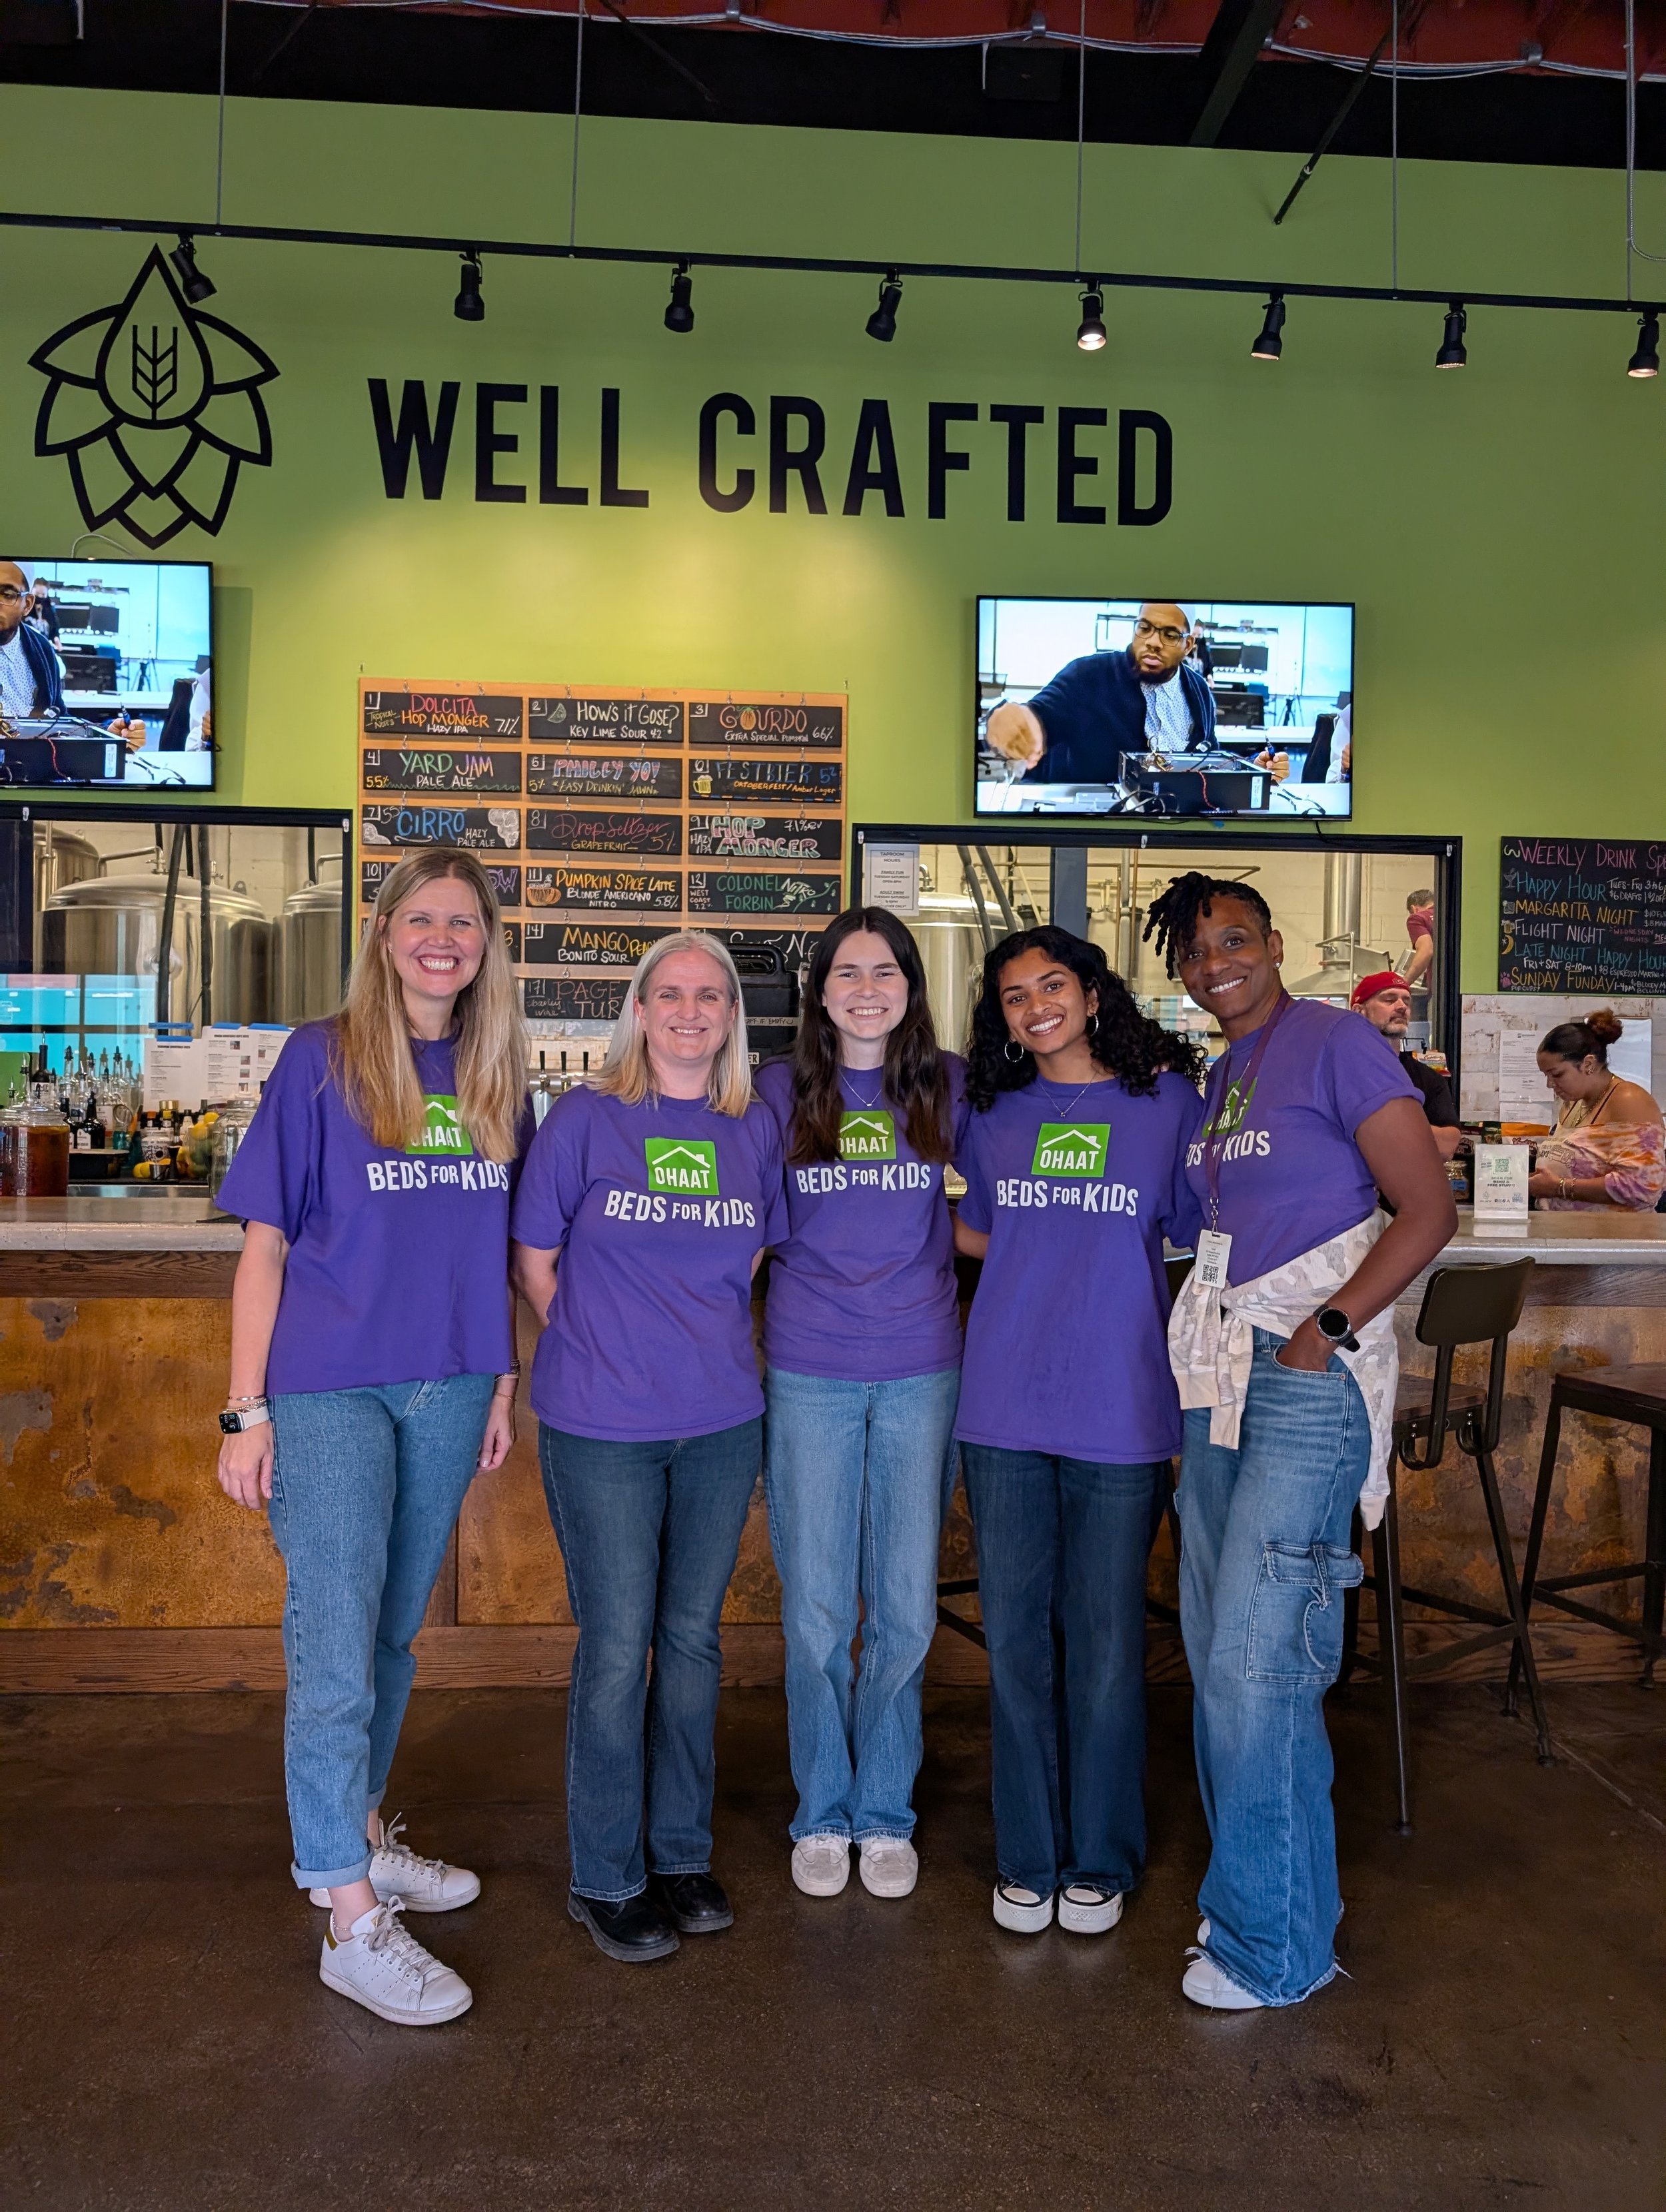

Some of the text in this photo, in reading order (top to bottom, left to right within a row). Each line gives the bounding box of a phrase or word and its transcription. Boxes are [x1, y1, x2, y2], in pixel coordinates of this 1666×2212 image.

[367, 378, 1173, 526] WELL CRAFTED
[411, 694, 477, 716] DOLCITA
[532, 701, 541, 711] 2
[695, 704, 704, 714] 3
[367, 710, 397, 722] TROPICAL
[402, 710, 489, 728] HOP MONGER
[577, 701, 619, 722] HOW'S
[638, 704, 680, 734] GOSE?
[427, 724, 468, 734] HAZY IPA
[570, 725, 588, 738] KEY
[592, 726, 616, 738] LIME
[620, 726, 647, 740] SOUR
[724, 731, 749, 741] EXTRA
[750, 732, 780, 742] SPECIAL
[367, 751, 376, 764] 4
[399, 751, 493, 778] YARD JAM
[552, 758, 660, 784] PHILLY YO!
[715, 762, 813, 784] FESTBIER
[416, 775, 474, 788] PALE ALE
[528, 778, 545, 792] 5%
[558, 780, 584, 793] EASY
[626, 785, 654, 795] JAWN
[367, 808, 375, 818] 7
[530, 810, 540, 827] 8
[690, 816, 700, 828] 9
[466, 828, 488, 839] HAZY
[551, 814, 671, 843] Drop Seltzer
[711, 816, 766, 838] HOP
[457, 837, 496, 847] PALE ALE
[690, 833, 712, 846] HAZY
[696, 844, 712, 853] IPA
[716, 837, 821, 858] MONGER
[1518, 839, 1587, 875] WEEKLY
[1597, 843, 1637, 869] DRINK
[367, 863, 379, 877] 10
[691, 873, 702, 885] 12
[556, 869, 676, 892] PUMPKIN SPICE LATTE
[716, 874, 783, 892] COLONEL
[1517, 870, 1607, 902] HAPPY HOUR
[566, 887, 651, 901] BLONDE AMERICANO
[725, 895, 774, 911] FORBIN
[588, 899, 617, 908] NITRO
[1515, 899, 1639, 925] MARGARITA NIGHT
[527, 923, 539, 936] 14
[562, 926, 629, 951] MANGO
[1514, 918, 1605, 945] FLIGHT NIGHT
[558, 948, 630, 963] BONITO SOUR
[1514, 941, 1545, 957] LATE
[1551, 943, 1591, 962] NIGHT
[1597, 947, 1633, 971] HAPPY
[1524, 956, 1538, 969] FRI
[1545, 959, 1563, 970] SAT
[528, 979, 540, 995] 17
[1511, 966, 1561, 991] SUNDAY
[1567, 969, 1615, 993] FUNDAY
[552, 981, 623, 1001] PAGE
[1222, 1130, 1271, 1161] KIDS
[1040, 1150, 1099, 1170] OHAAT
[367, 1160, 509, 1192] BEDS FOR KIDS
[654, 1167, 710, 1189] OHAAT
[796, 1162, 930, 1193] BEDS FOR KIDS
[996, 1179, 1138, 1216] BEDS FOR KIDS
[604, 1190, 756, 1228] BEDS FOR KIDS
